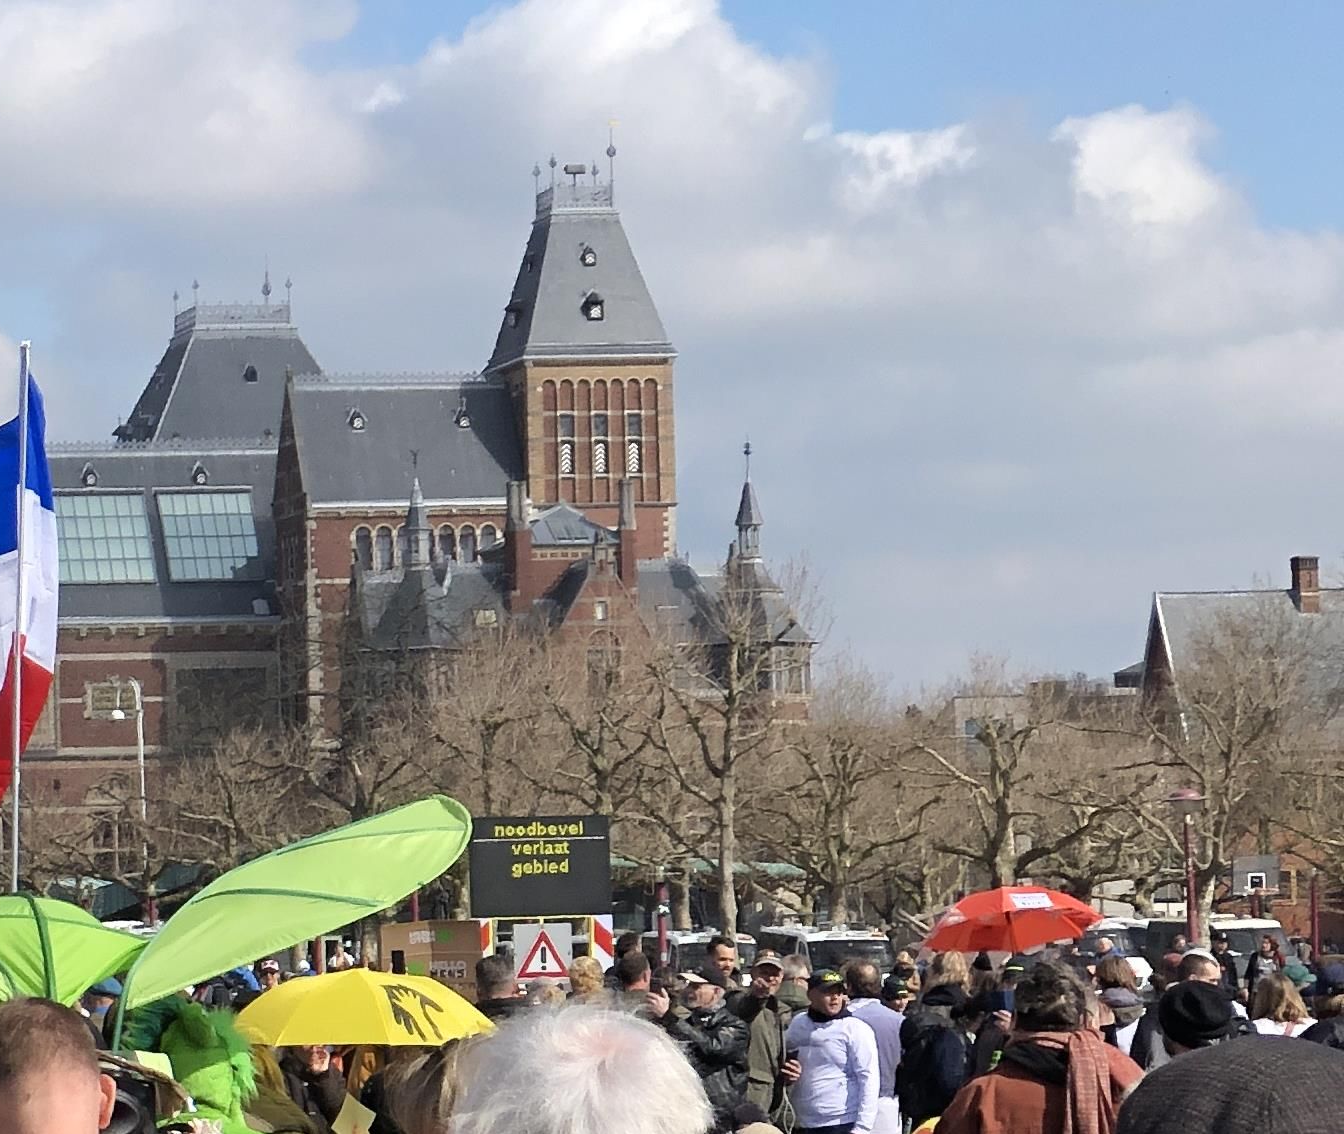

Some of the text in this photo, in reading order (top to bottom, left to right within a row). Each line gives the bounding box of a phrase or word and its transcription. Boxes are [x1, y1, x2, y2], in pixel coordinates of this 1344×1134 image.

[494, 821, 584, 837] noodbevel
[512, 841, 570, 855] verlaat
[511, 859, 570, 878] gebied
